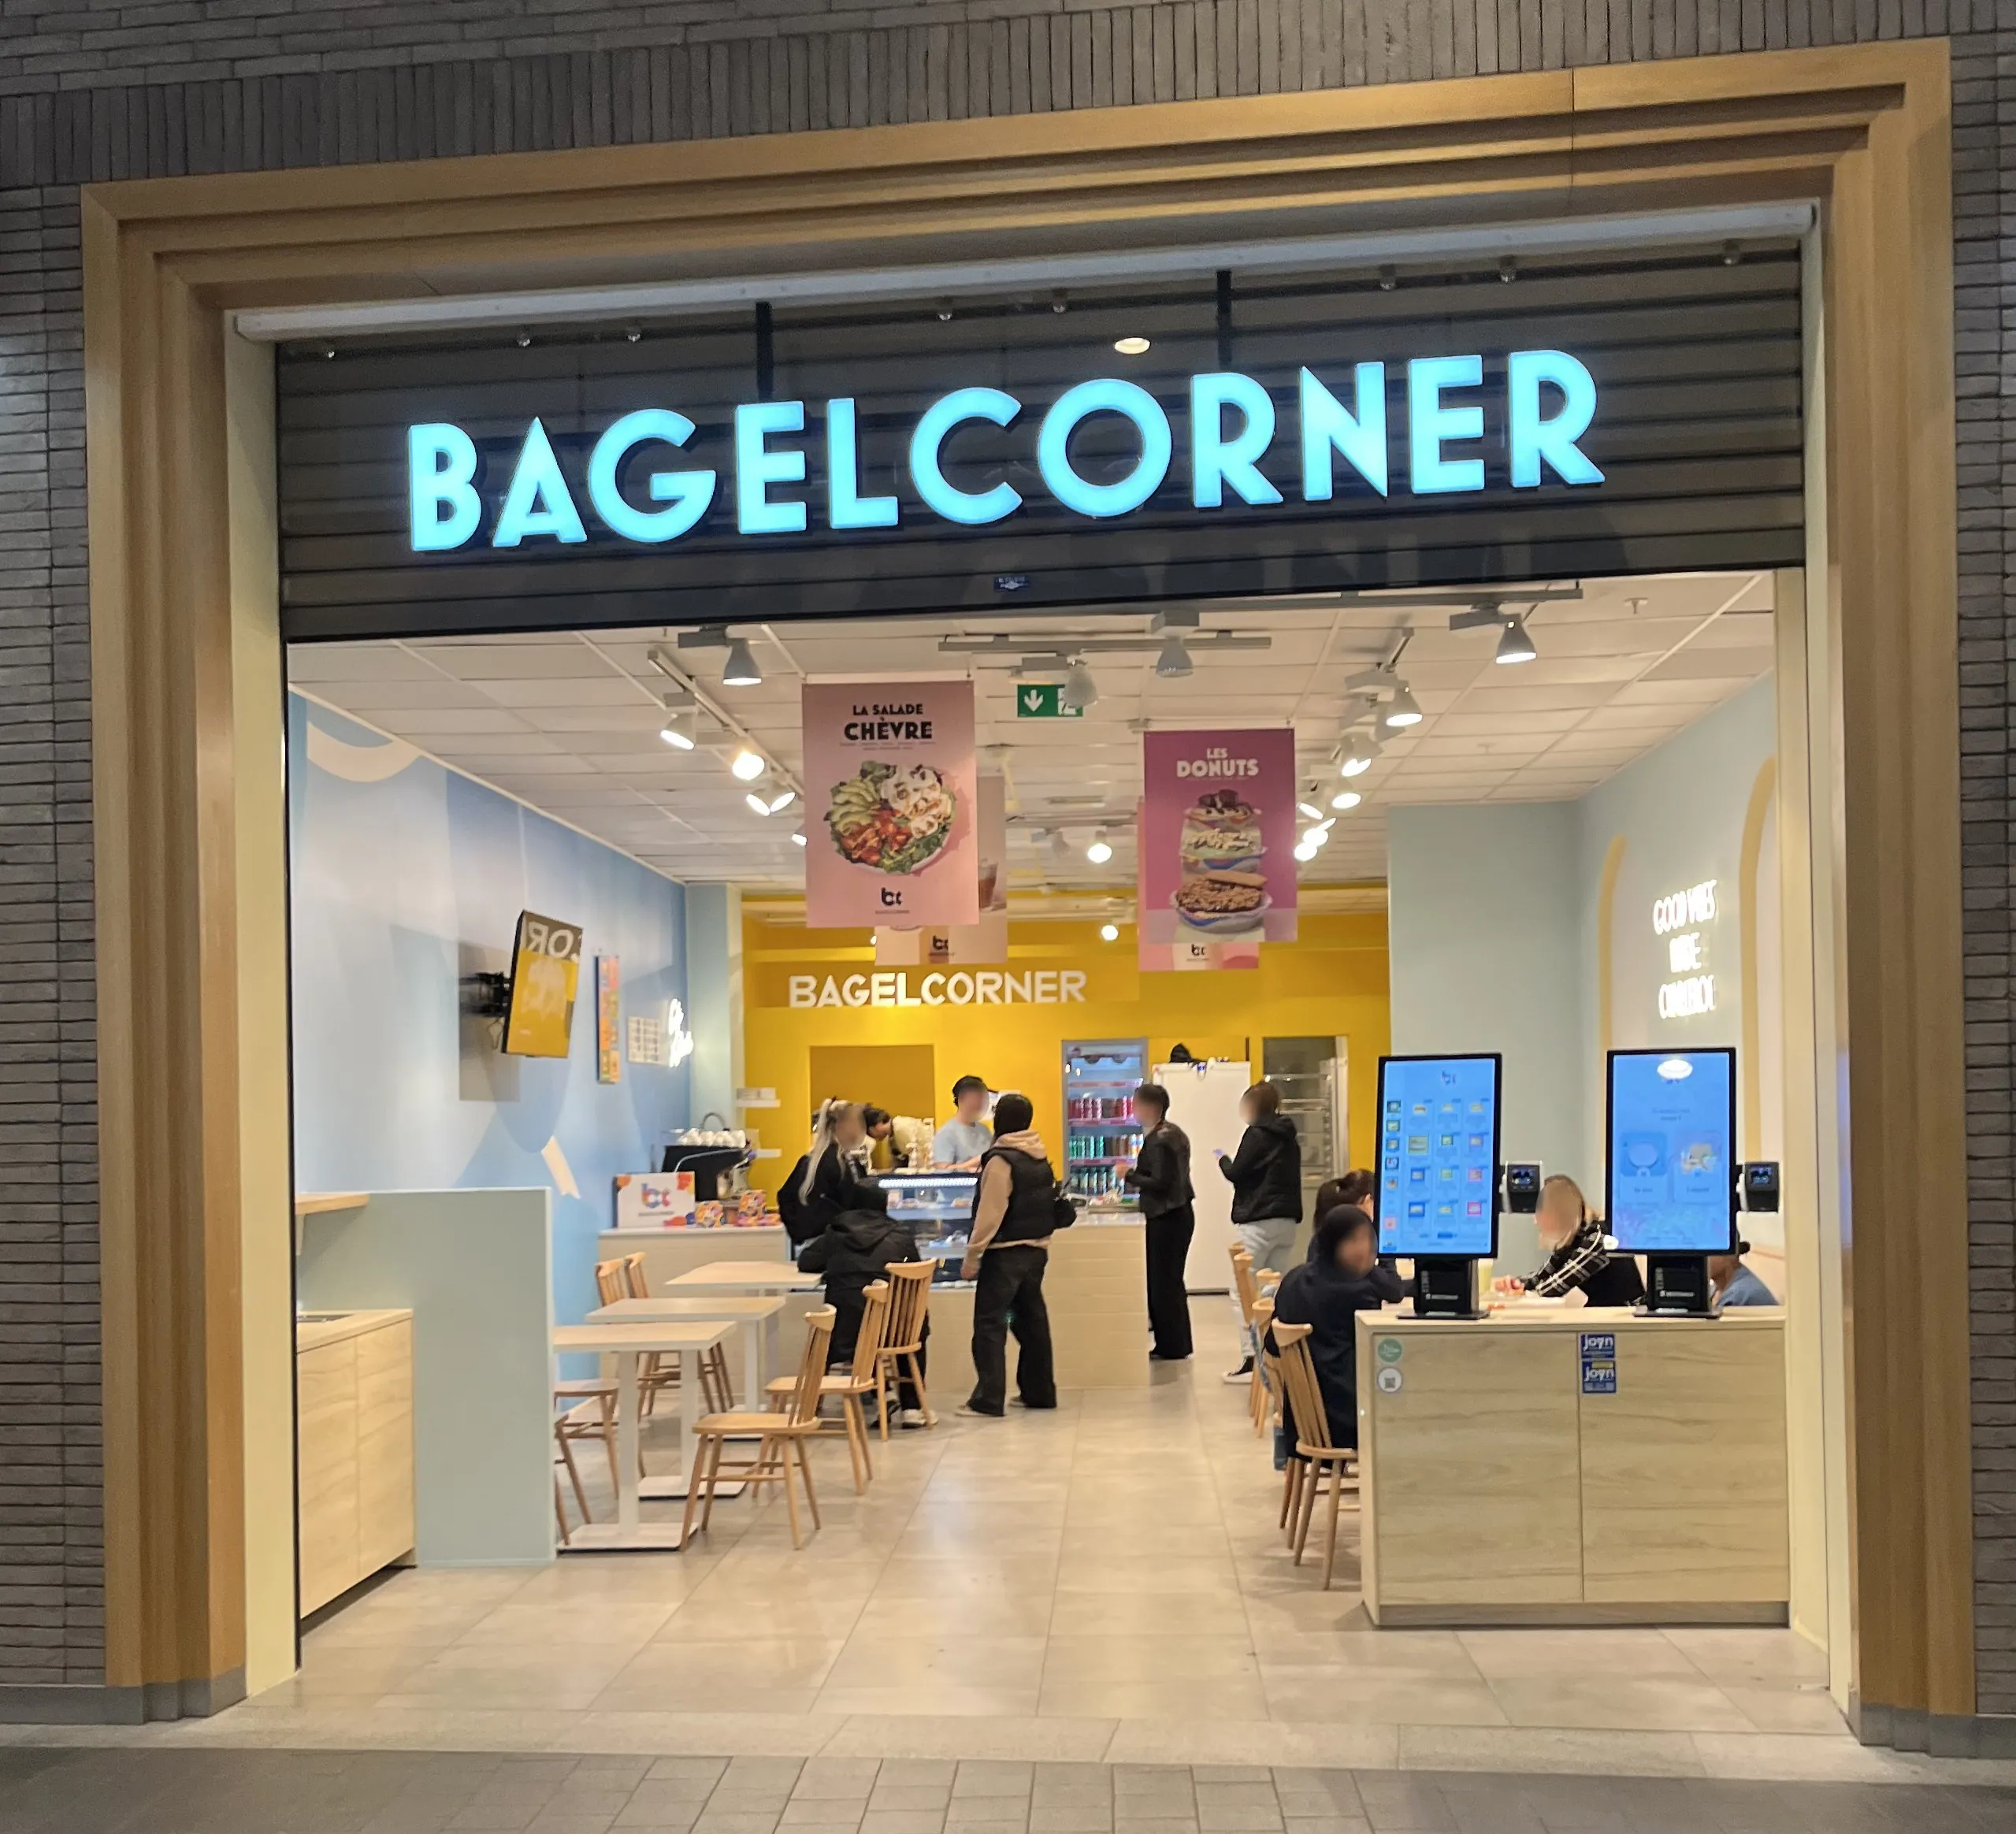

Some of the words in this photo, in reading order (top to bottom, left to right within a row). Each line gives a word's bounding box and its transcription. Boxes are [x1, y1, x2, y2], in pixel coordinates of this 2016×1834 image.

[409, 349, 1606, 552] BAGELCORNER
[852, 705, 868, 715] LA
[872, 704, 923, 715] SALADE
[844, 716, 933, 741] CHÈVRE
[1206, 748, 1228, 759] LES
[1177, 759, 1259, 778] DONUTS
[789, 971, 1087, 1008] BAGELCORNER
